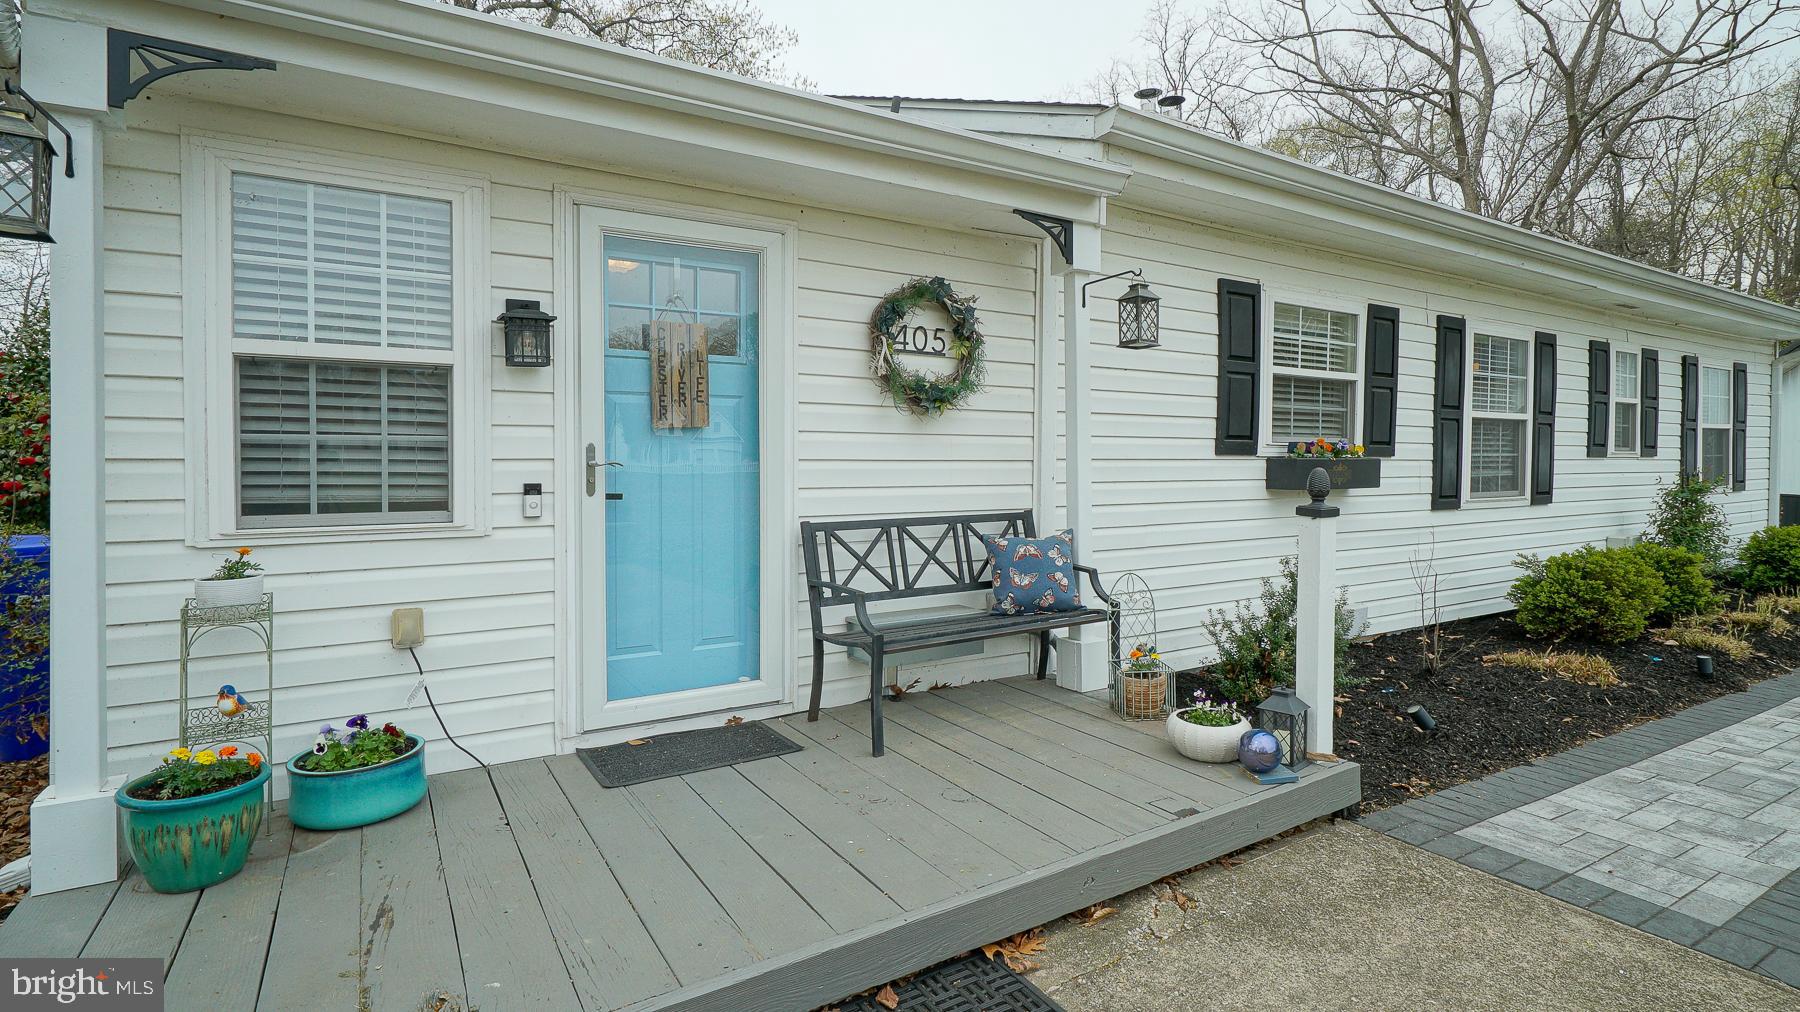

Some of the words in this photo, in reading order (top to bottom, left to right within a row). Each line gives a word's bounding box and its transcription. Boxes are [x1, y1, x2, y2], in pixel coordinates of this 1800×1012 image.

[893, 324, 946, 353] 405
[657, 327, 668, 421] CHESTER
[677, 343, 687, 408] RIVER
[696, 350, 705, 403] LIFE
